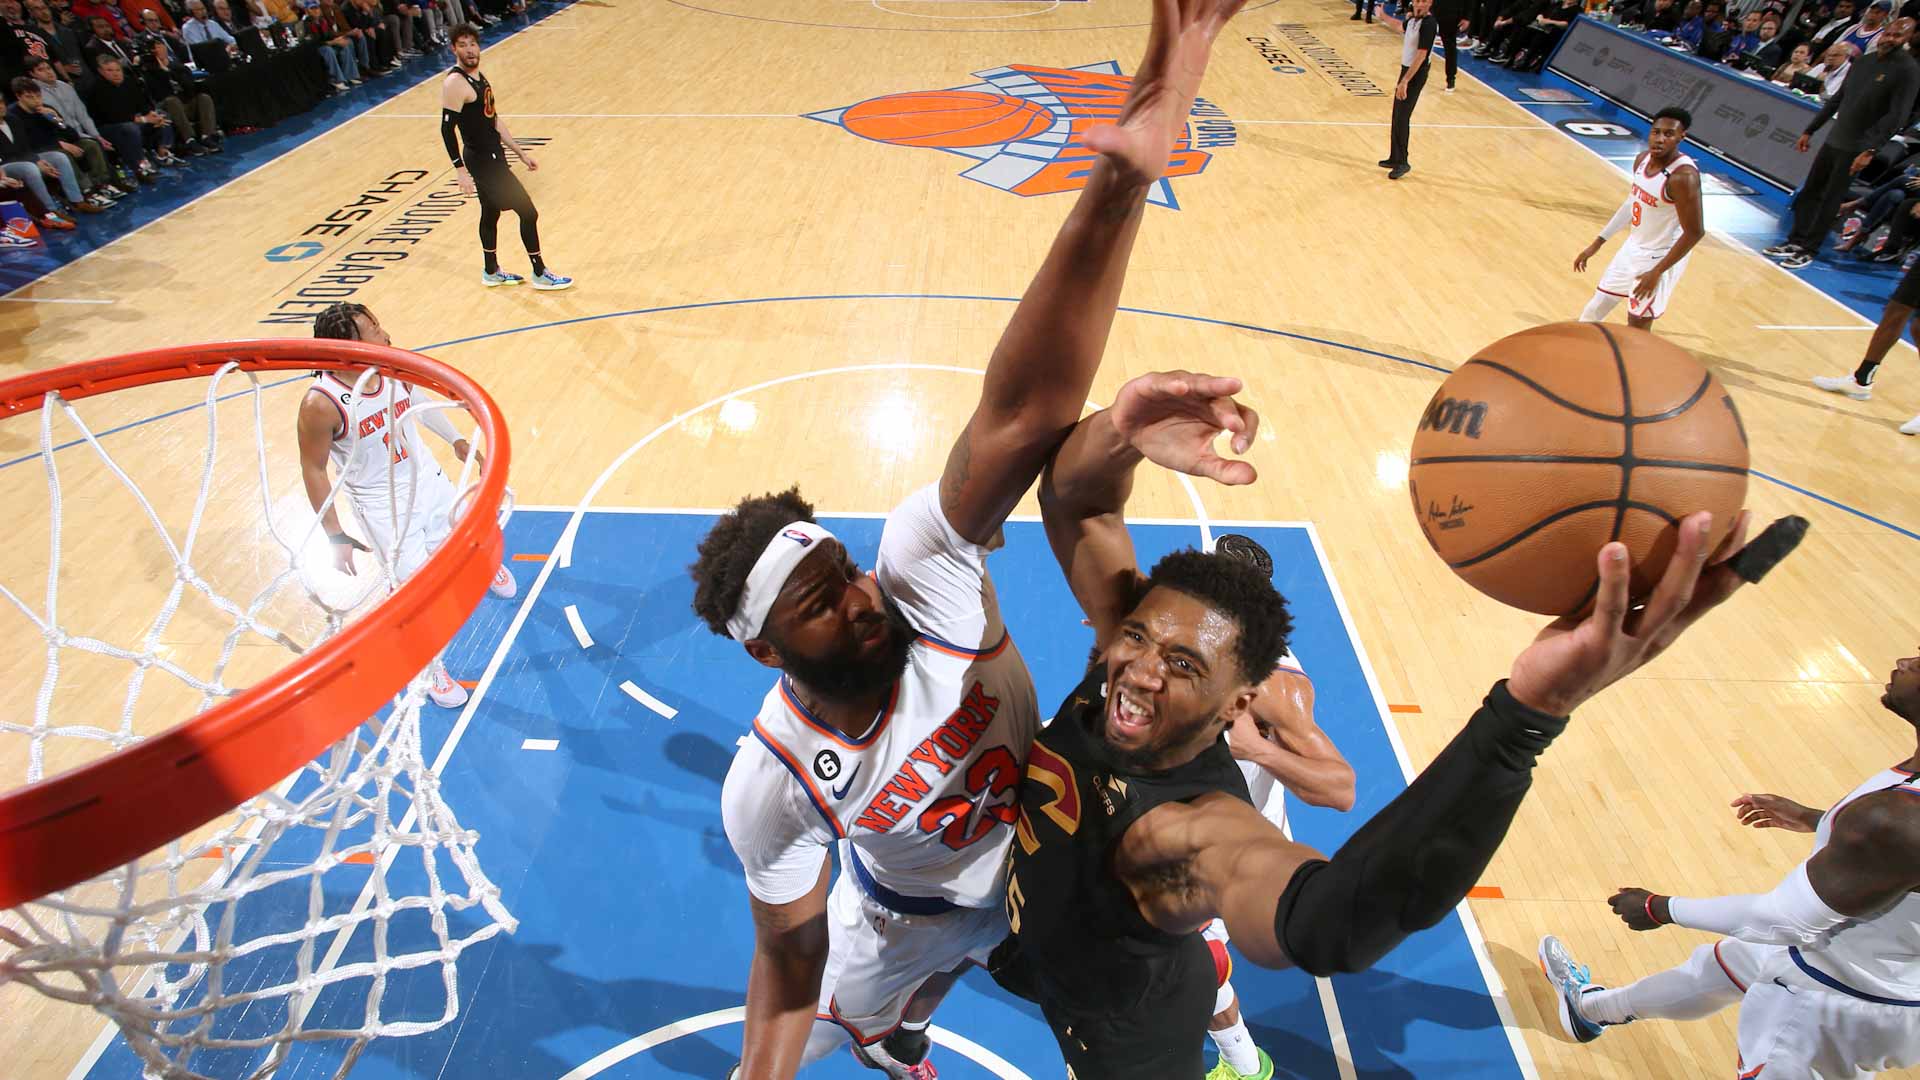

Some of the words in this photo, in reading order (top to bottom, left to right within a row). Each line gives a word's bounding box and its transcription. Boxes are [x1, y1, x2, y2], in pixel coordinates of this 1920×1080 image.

[1246, 37, 1295, 65] CHASE
[1194, 119, 1237, 148] YORK
[1768, 127, 1799, 146] ESP
[301, 170, 429, 237] CHASE
[364, 190, 479, 246] SQUARE
[258, 250, 409, 324] GARDEN
[854, 760, 927, 834] NEW
[909, 680, 1000, 777] YORK
[917, 744, 1022, 851] 23
